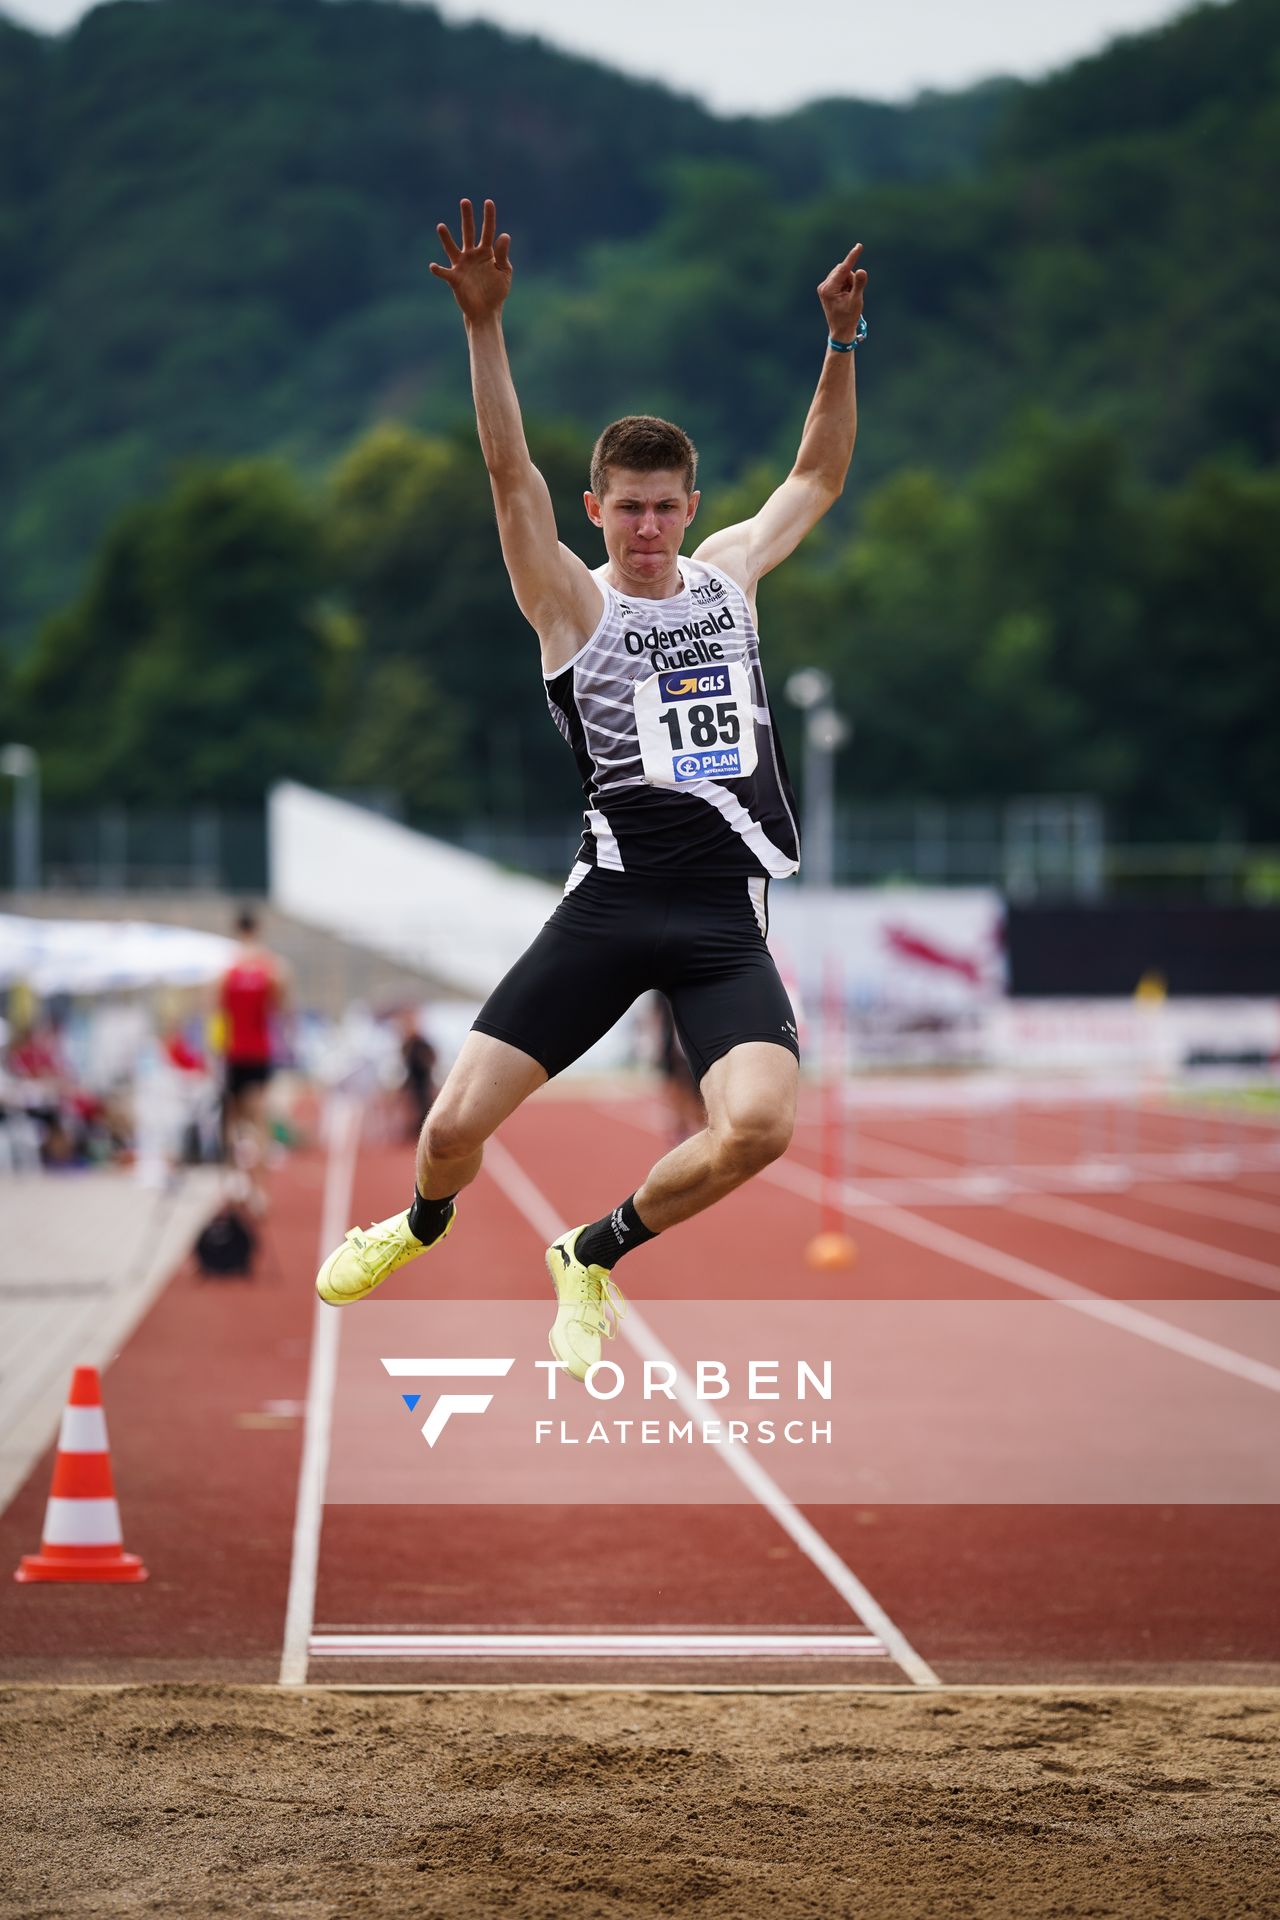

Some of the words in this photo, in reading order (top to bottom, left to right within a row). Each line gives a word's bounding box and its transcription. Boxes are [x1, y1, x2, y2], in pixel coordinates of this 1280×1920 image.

[690, 578, 722, 599] MTG
[624, 606, 736, 655] Odenwald
[651, 639, 725, 671] Quelle
[698, 674, 725, 692] GLS
[658, 701, 740, 750] 185
[702, 753, 738, 769] PLAN
